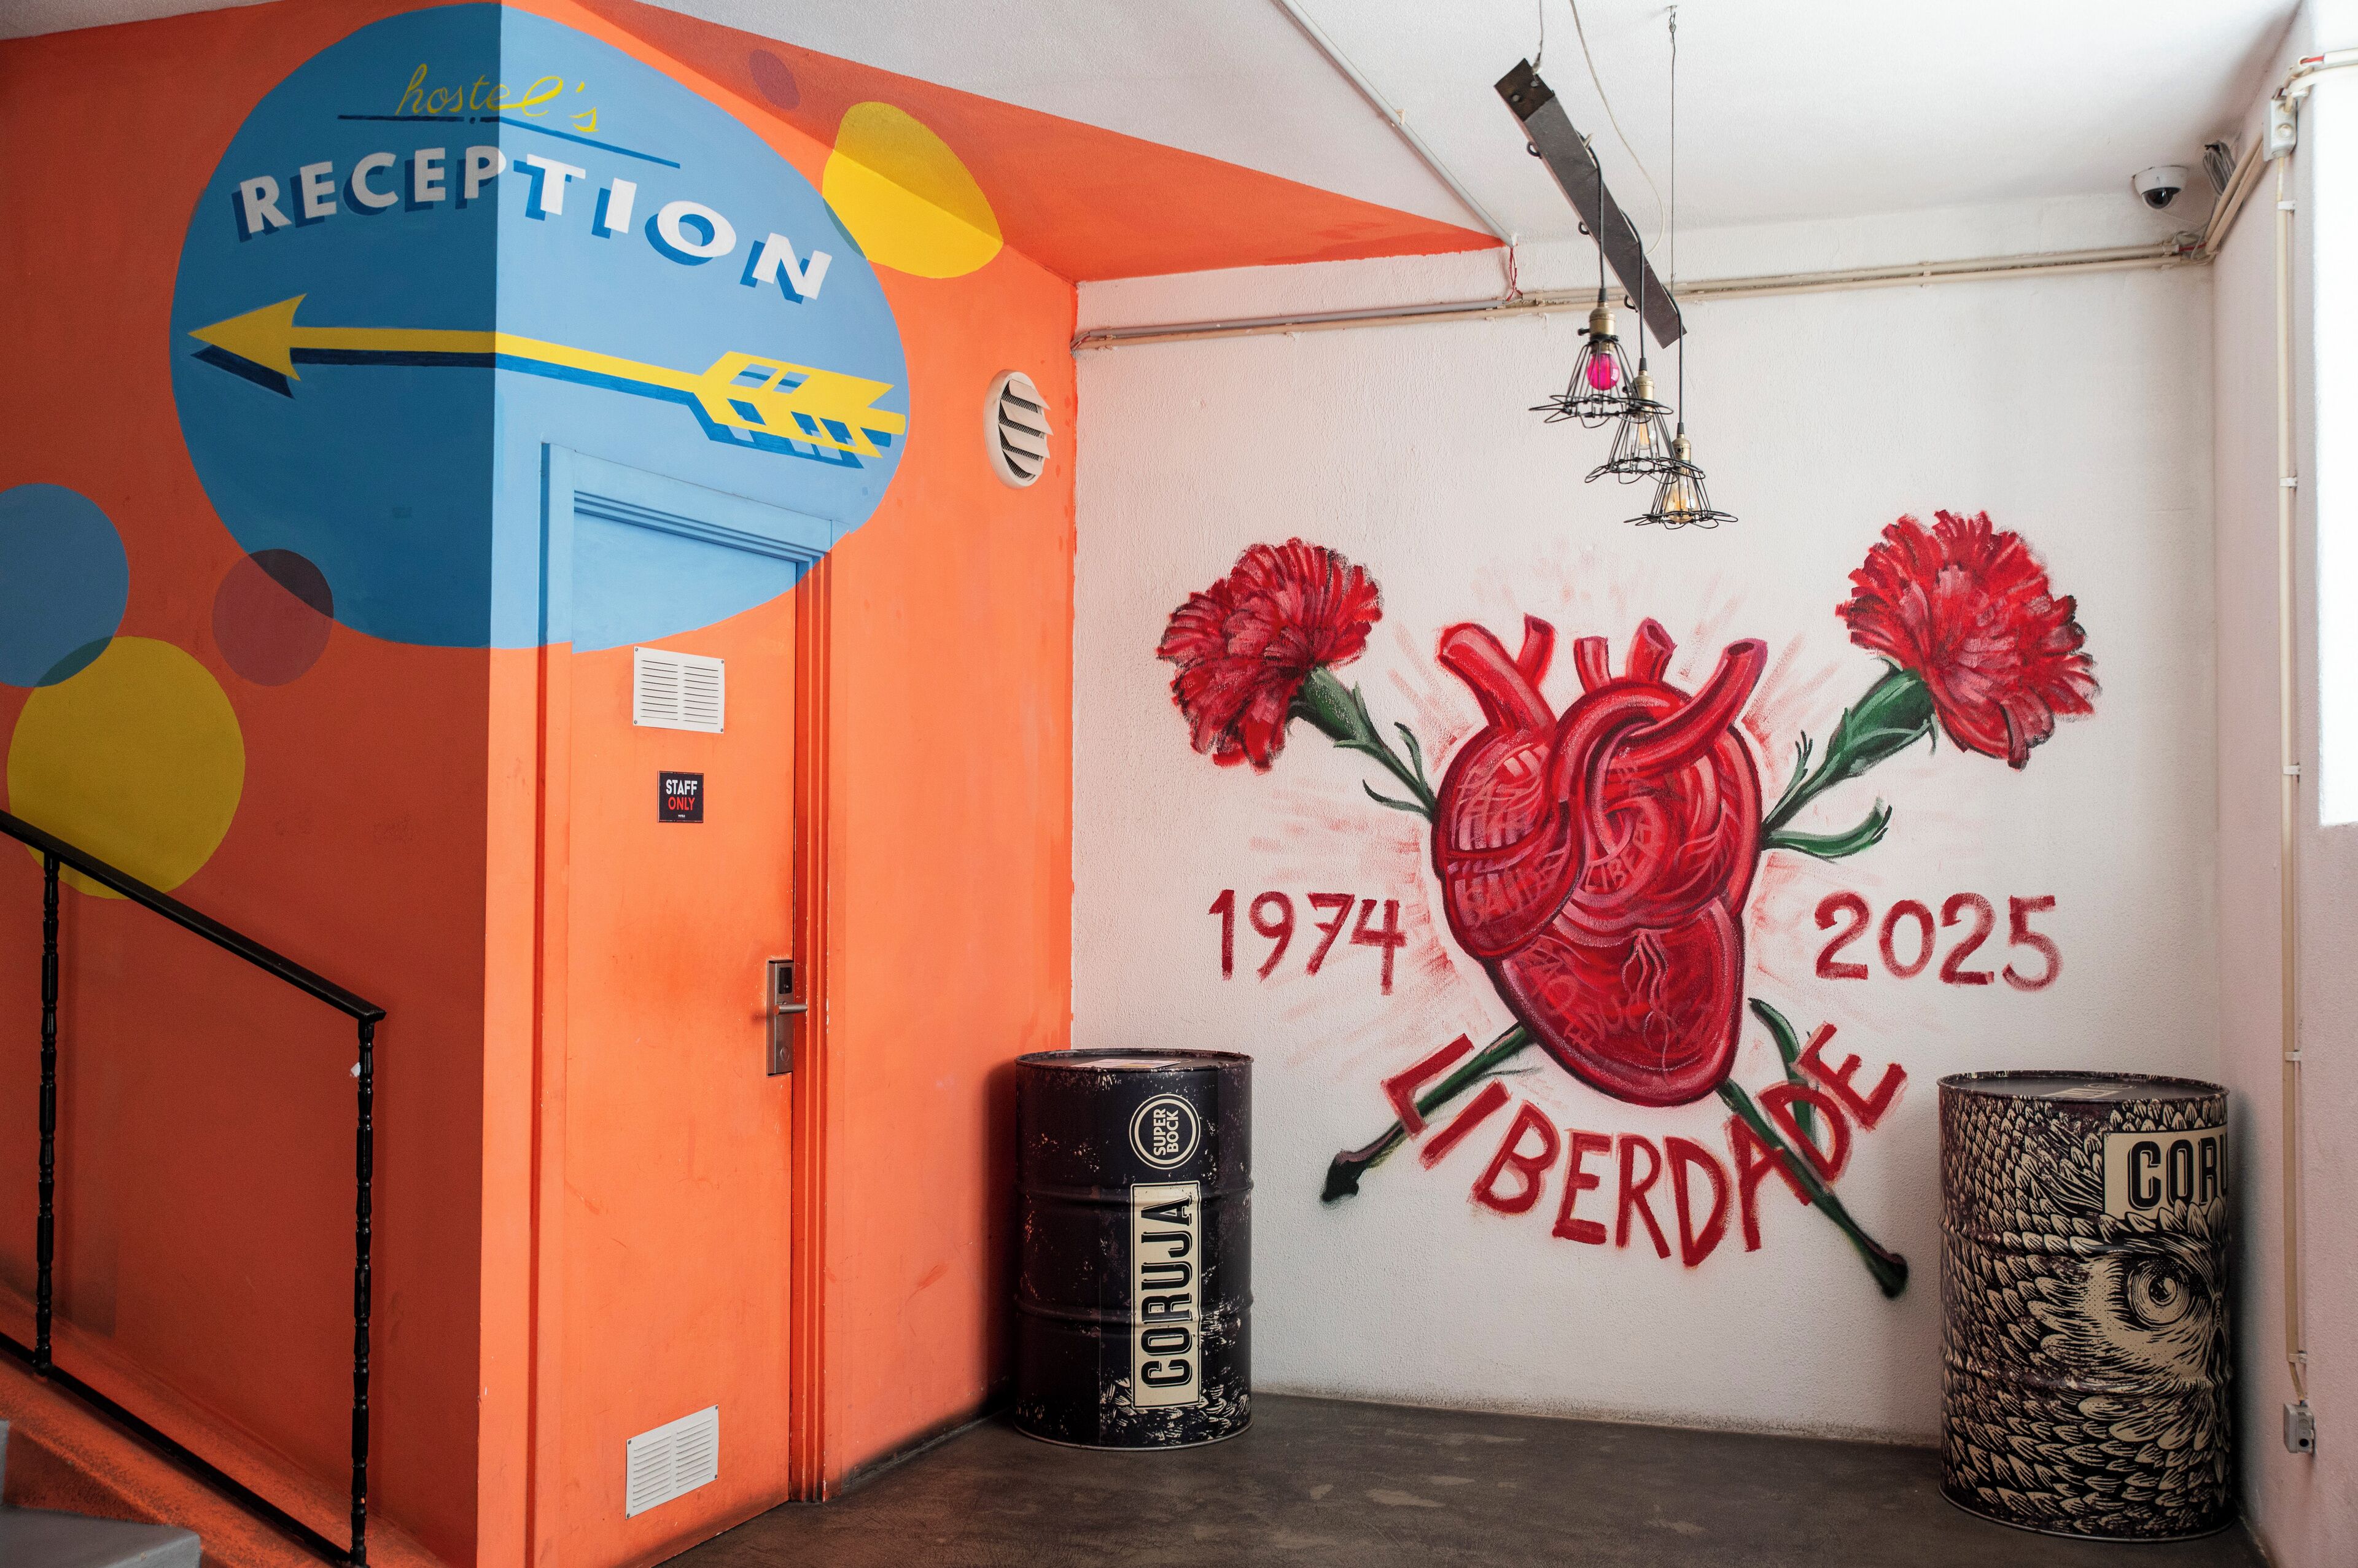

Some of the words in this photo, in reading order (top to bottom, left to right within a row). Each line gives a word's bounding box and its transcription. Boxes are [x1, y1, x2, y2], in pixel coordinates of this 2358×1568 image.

[395, 63, 599, 133] hostel's
[232, 146, 833, 304] RECEPTION
[666, 779, 698, 795] STAFF
[667, 796, 695, 810] ONLY
[1208, 888, 1407, 996] 1974
[1814, 888, 2064, 992] 2025
[1153, 1108, 1166, 1156] SUPER
[1166, 1109, 1179, 1153] BOCK
[1380, 1021, 1907, 1268] LIBERDADE
[1140, 1195, 1193, 1389] CORUJA
